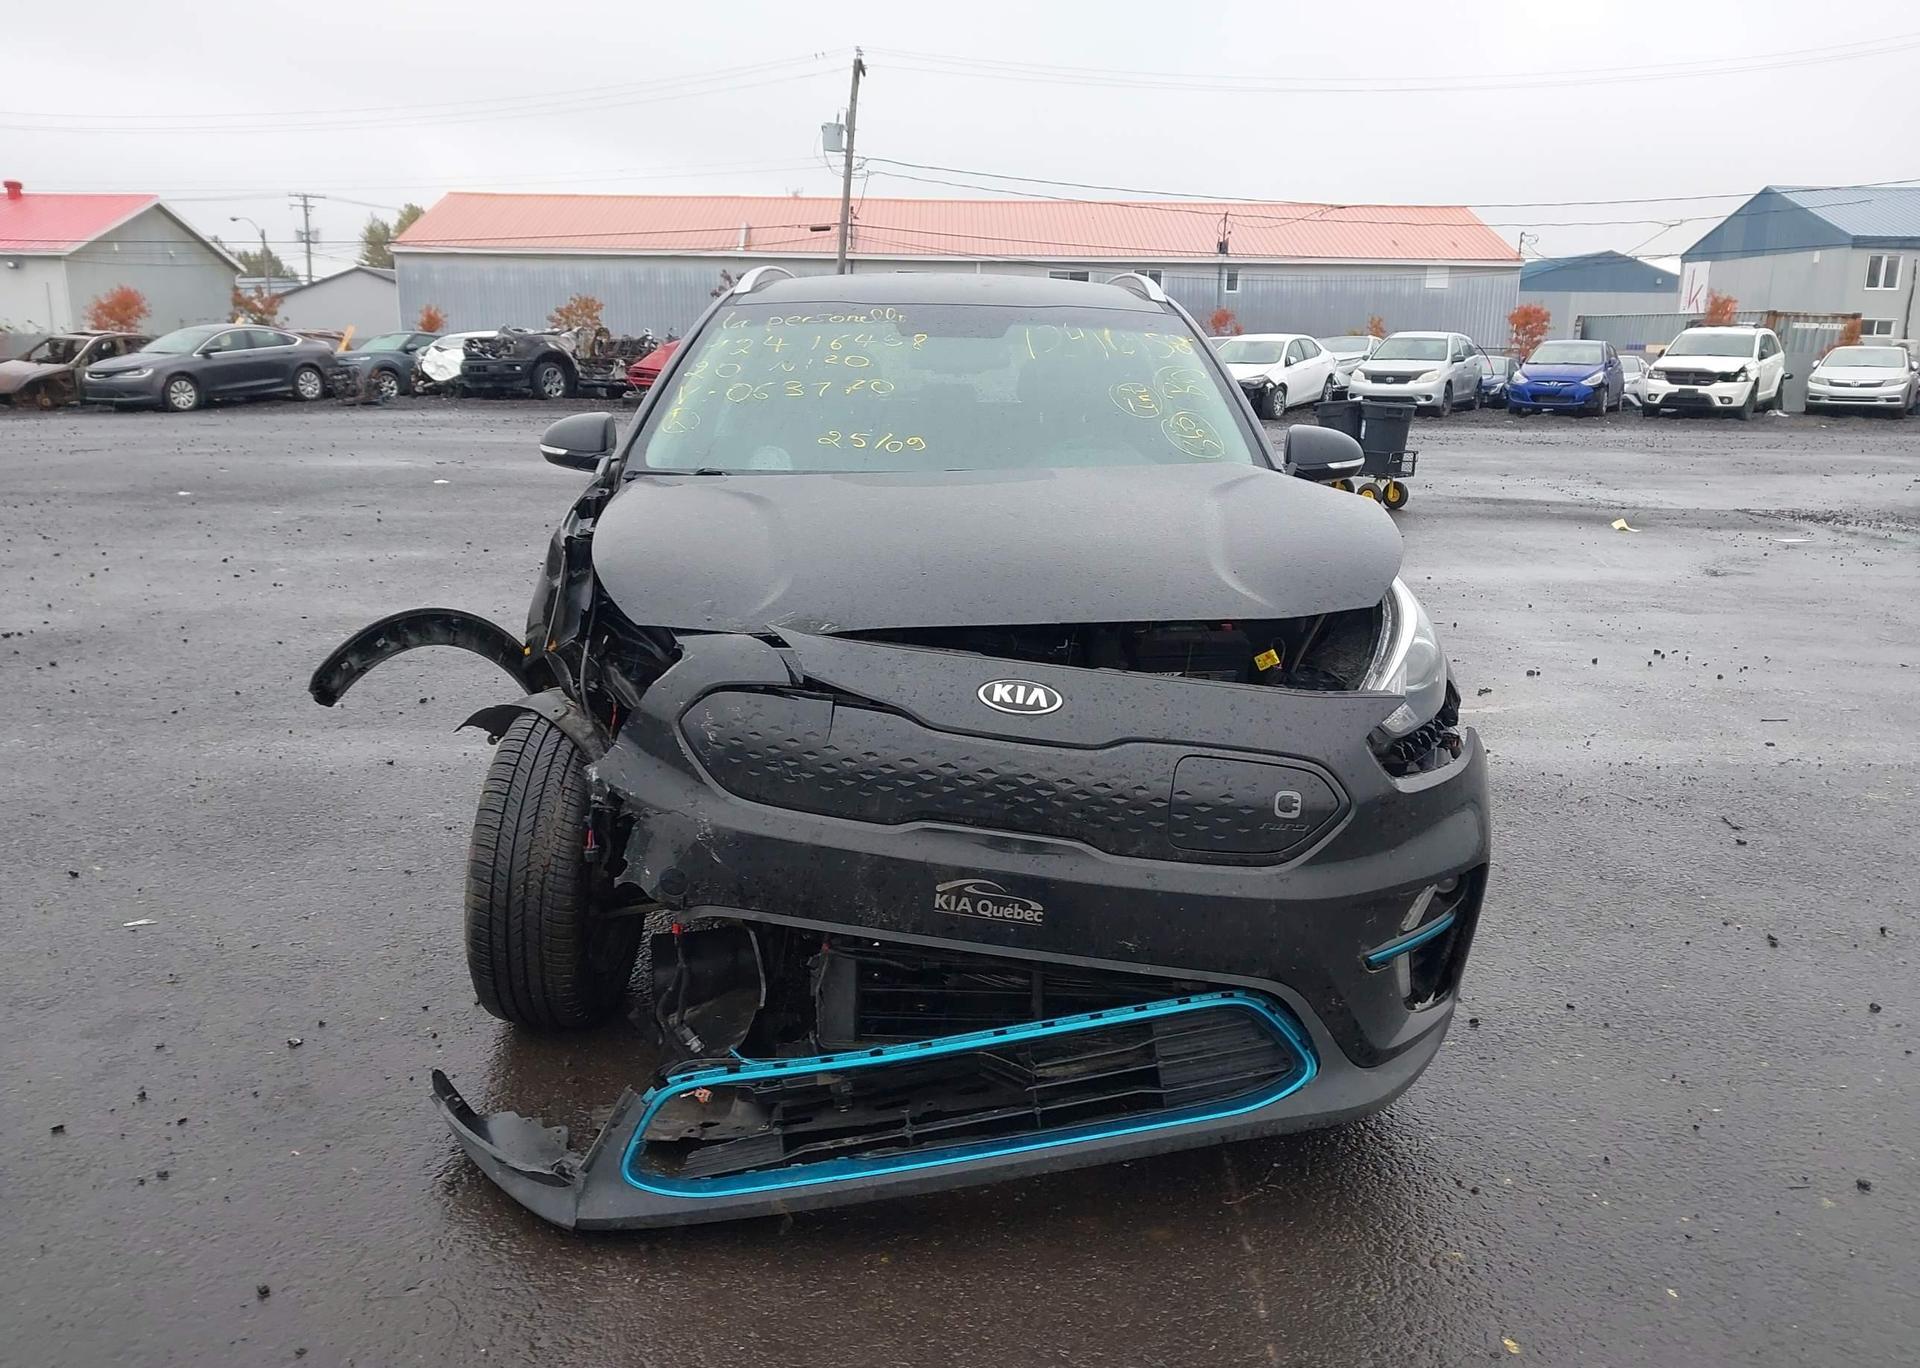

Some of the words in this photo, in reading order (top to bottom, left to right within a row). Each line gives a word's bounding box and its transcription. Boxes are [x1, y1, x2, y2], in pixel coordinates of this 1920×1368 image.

[817, 430, 927, 453] 25/09
[992, 683, 1048, 708] KIA
[934, 893, 973, 913] KIA
[976, 899, 1044, 923] Québec
